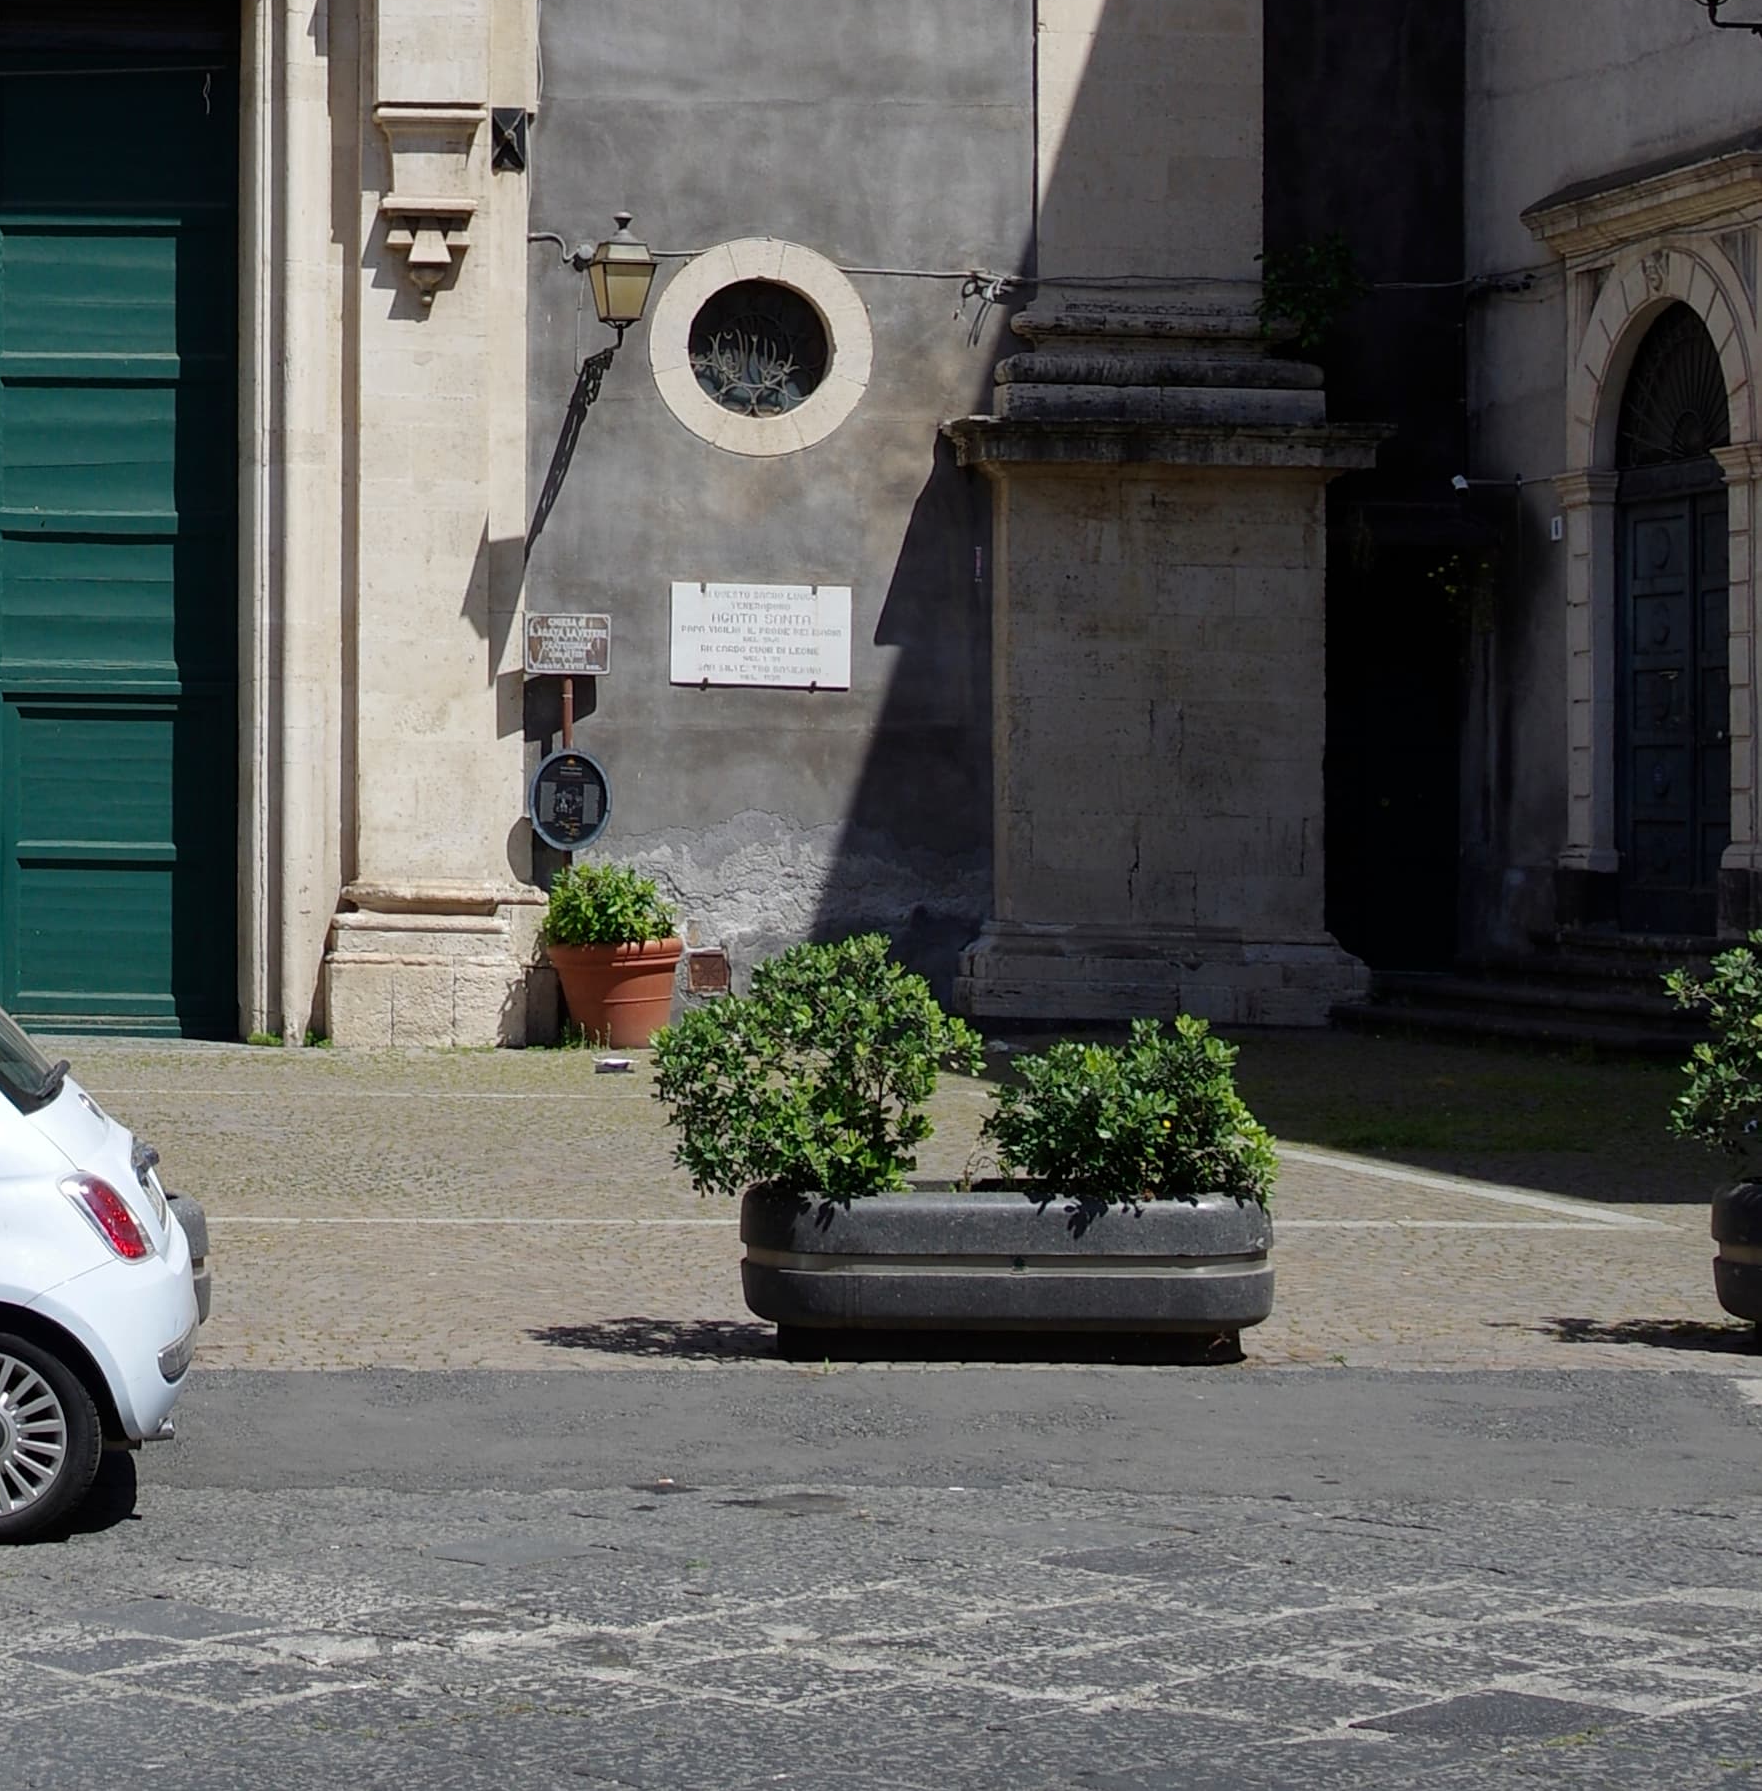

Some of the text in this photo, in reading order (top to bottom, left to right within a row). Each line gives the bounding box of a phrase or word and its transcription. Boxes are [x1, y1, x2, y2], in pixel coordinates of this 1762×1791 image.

[711, 612, 811, 626] AGATA SANTA
[681, 624, 705, 634] PAPA
[788, 647, 820, 657] LEONE
